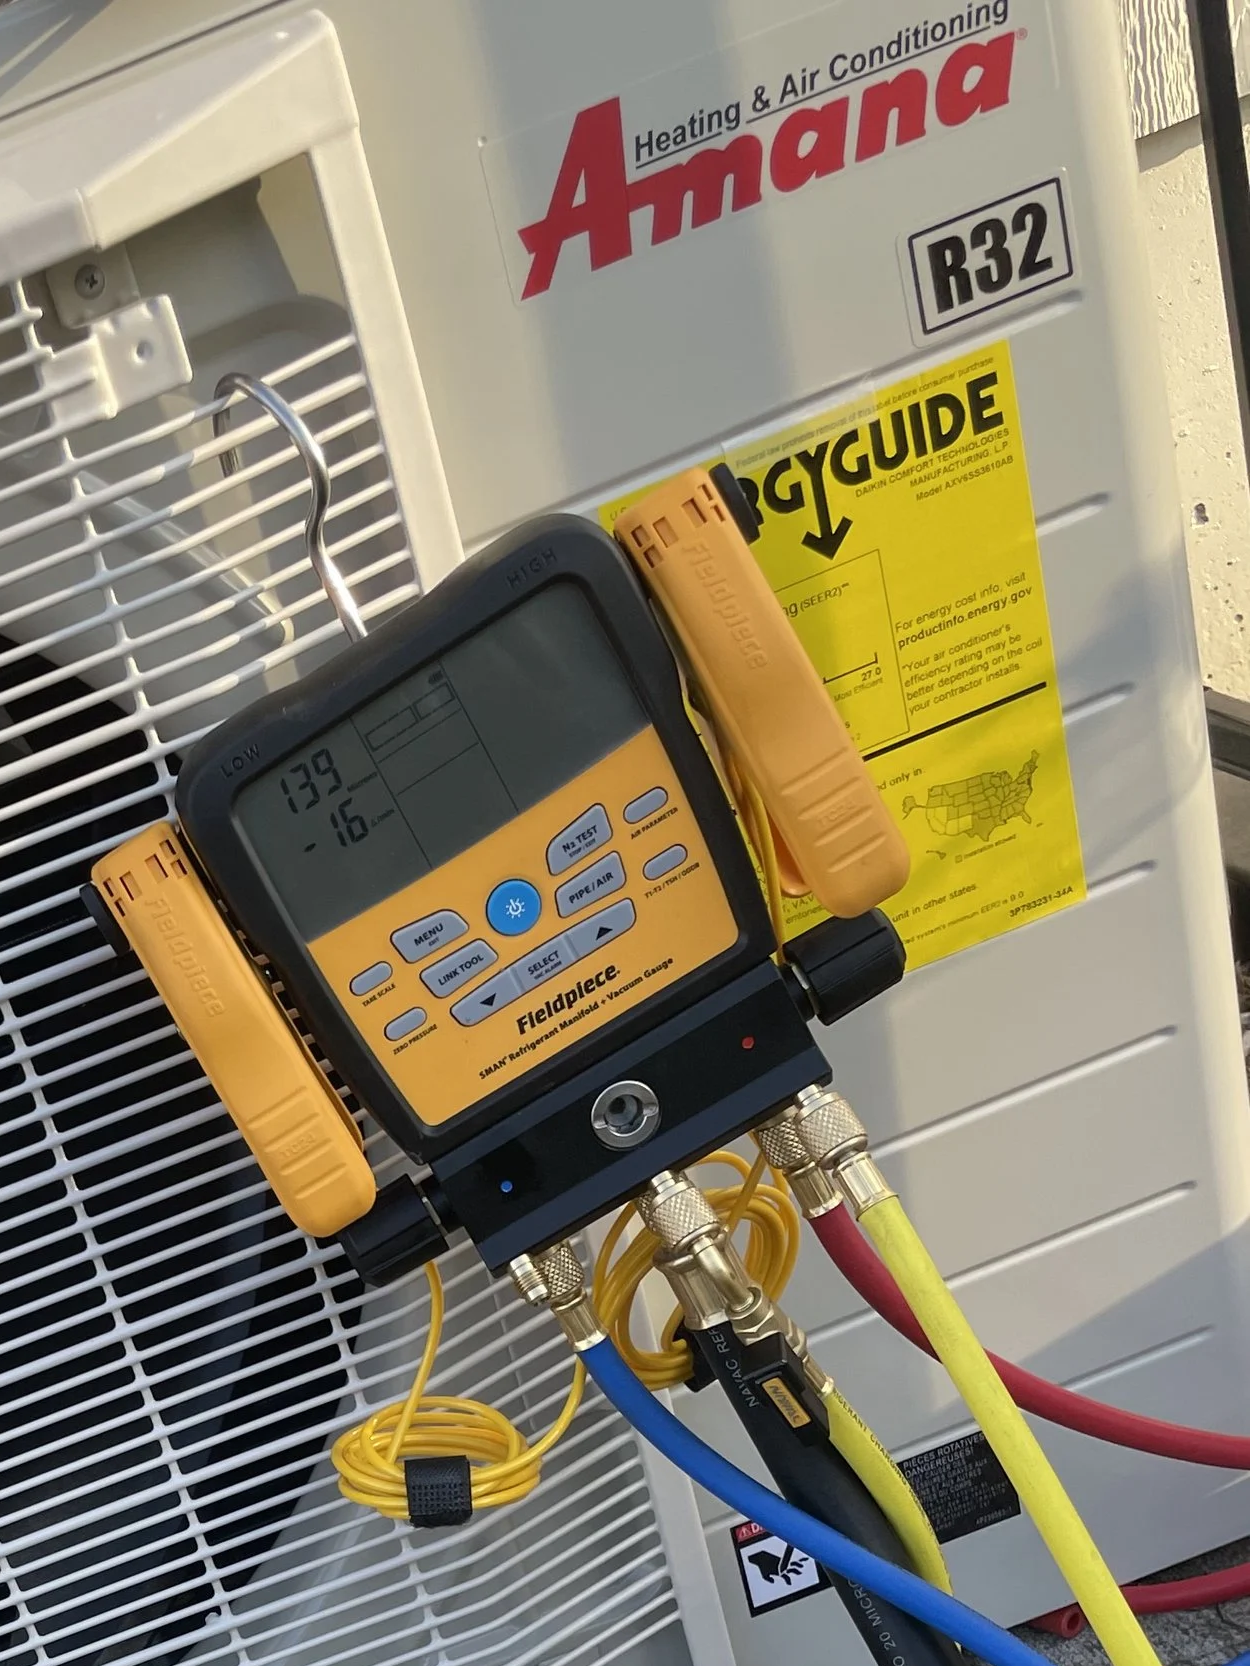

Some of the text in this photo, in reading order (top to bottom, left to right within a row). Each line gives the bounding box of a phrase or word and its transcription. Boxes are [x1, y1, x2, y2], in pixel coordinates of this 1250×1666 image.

[635, 0, 1009, 162] Heating & Air Conditioning
[517, 31, 1016, 300] Amana
[928, 202, 1053, 314] R32
[736, 371, 1004, 520] RGYGUIDE
[855, 428, 1009, 498] DAIKIN COMFORT TECHNOLOGIES
[916, 485, 942, 501] Model
[506, 547, 558, 589] HIGH
[681, 541, 768, 670] Fieldpiece
[895, 619, 913, 633] For
[916, 604, 952, 625] energy
[955, 593, 977, 609] cost
[1005, 572, 1026, 588] visit
[897, 586, 1033, 650] productinfo.energy.gov
[904, 633, 1021, 689] efficiency rating may be
[933, 622, 1011, 662] air conditioner's
[906, 636, 1043, 701] better depending on the coil
[909, 700, 931, 716] your
[933, 678, 984, 704] contractor
[220, 744, 260, 779] LOW
[280, 748, 342, 814] 139
[889, 771, 911, 787] only
[575, 825, 599, 845] TEST
[630, 806, 679, 840] AIR PARAMETER
[568, 871, 614, 904] PIPE AIR
[892, 908, 910, 923] unit
[912, 905, 921, 916] in
[922, 894, 947, 911] other
[144, 893, 226, 1018] Fieldpiece
[413, 923, 444, 947] MENU
[438, 954, 484, 986] LINK TOOL
[527, 950, 560, 976] SELECT
[376, 983, 396, 999] SCALE
[515, 964, 618, 1036] Fieldpiece
[393, 1023, 438, 1056] ZERO PRESSURE
[479, 957, 674, 1080] SMAN Refrigerant Manifold Vacuum Gauge
[725, 1359, 760, 1408] NAVAC
[879, 1631, 897, 1651] 20
